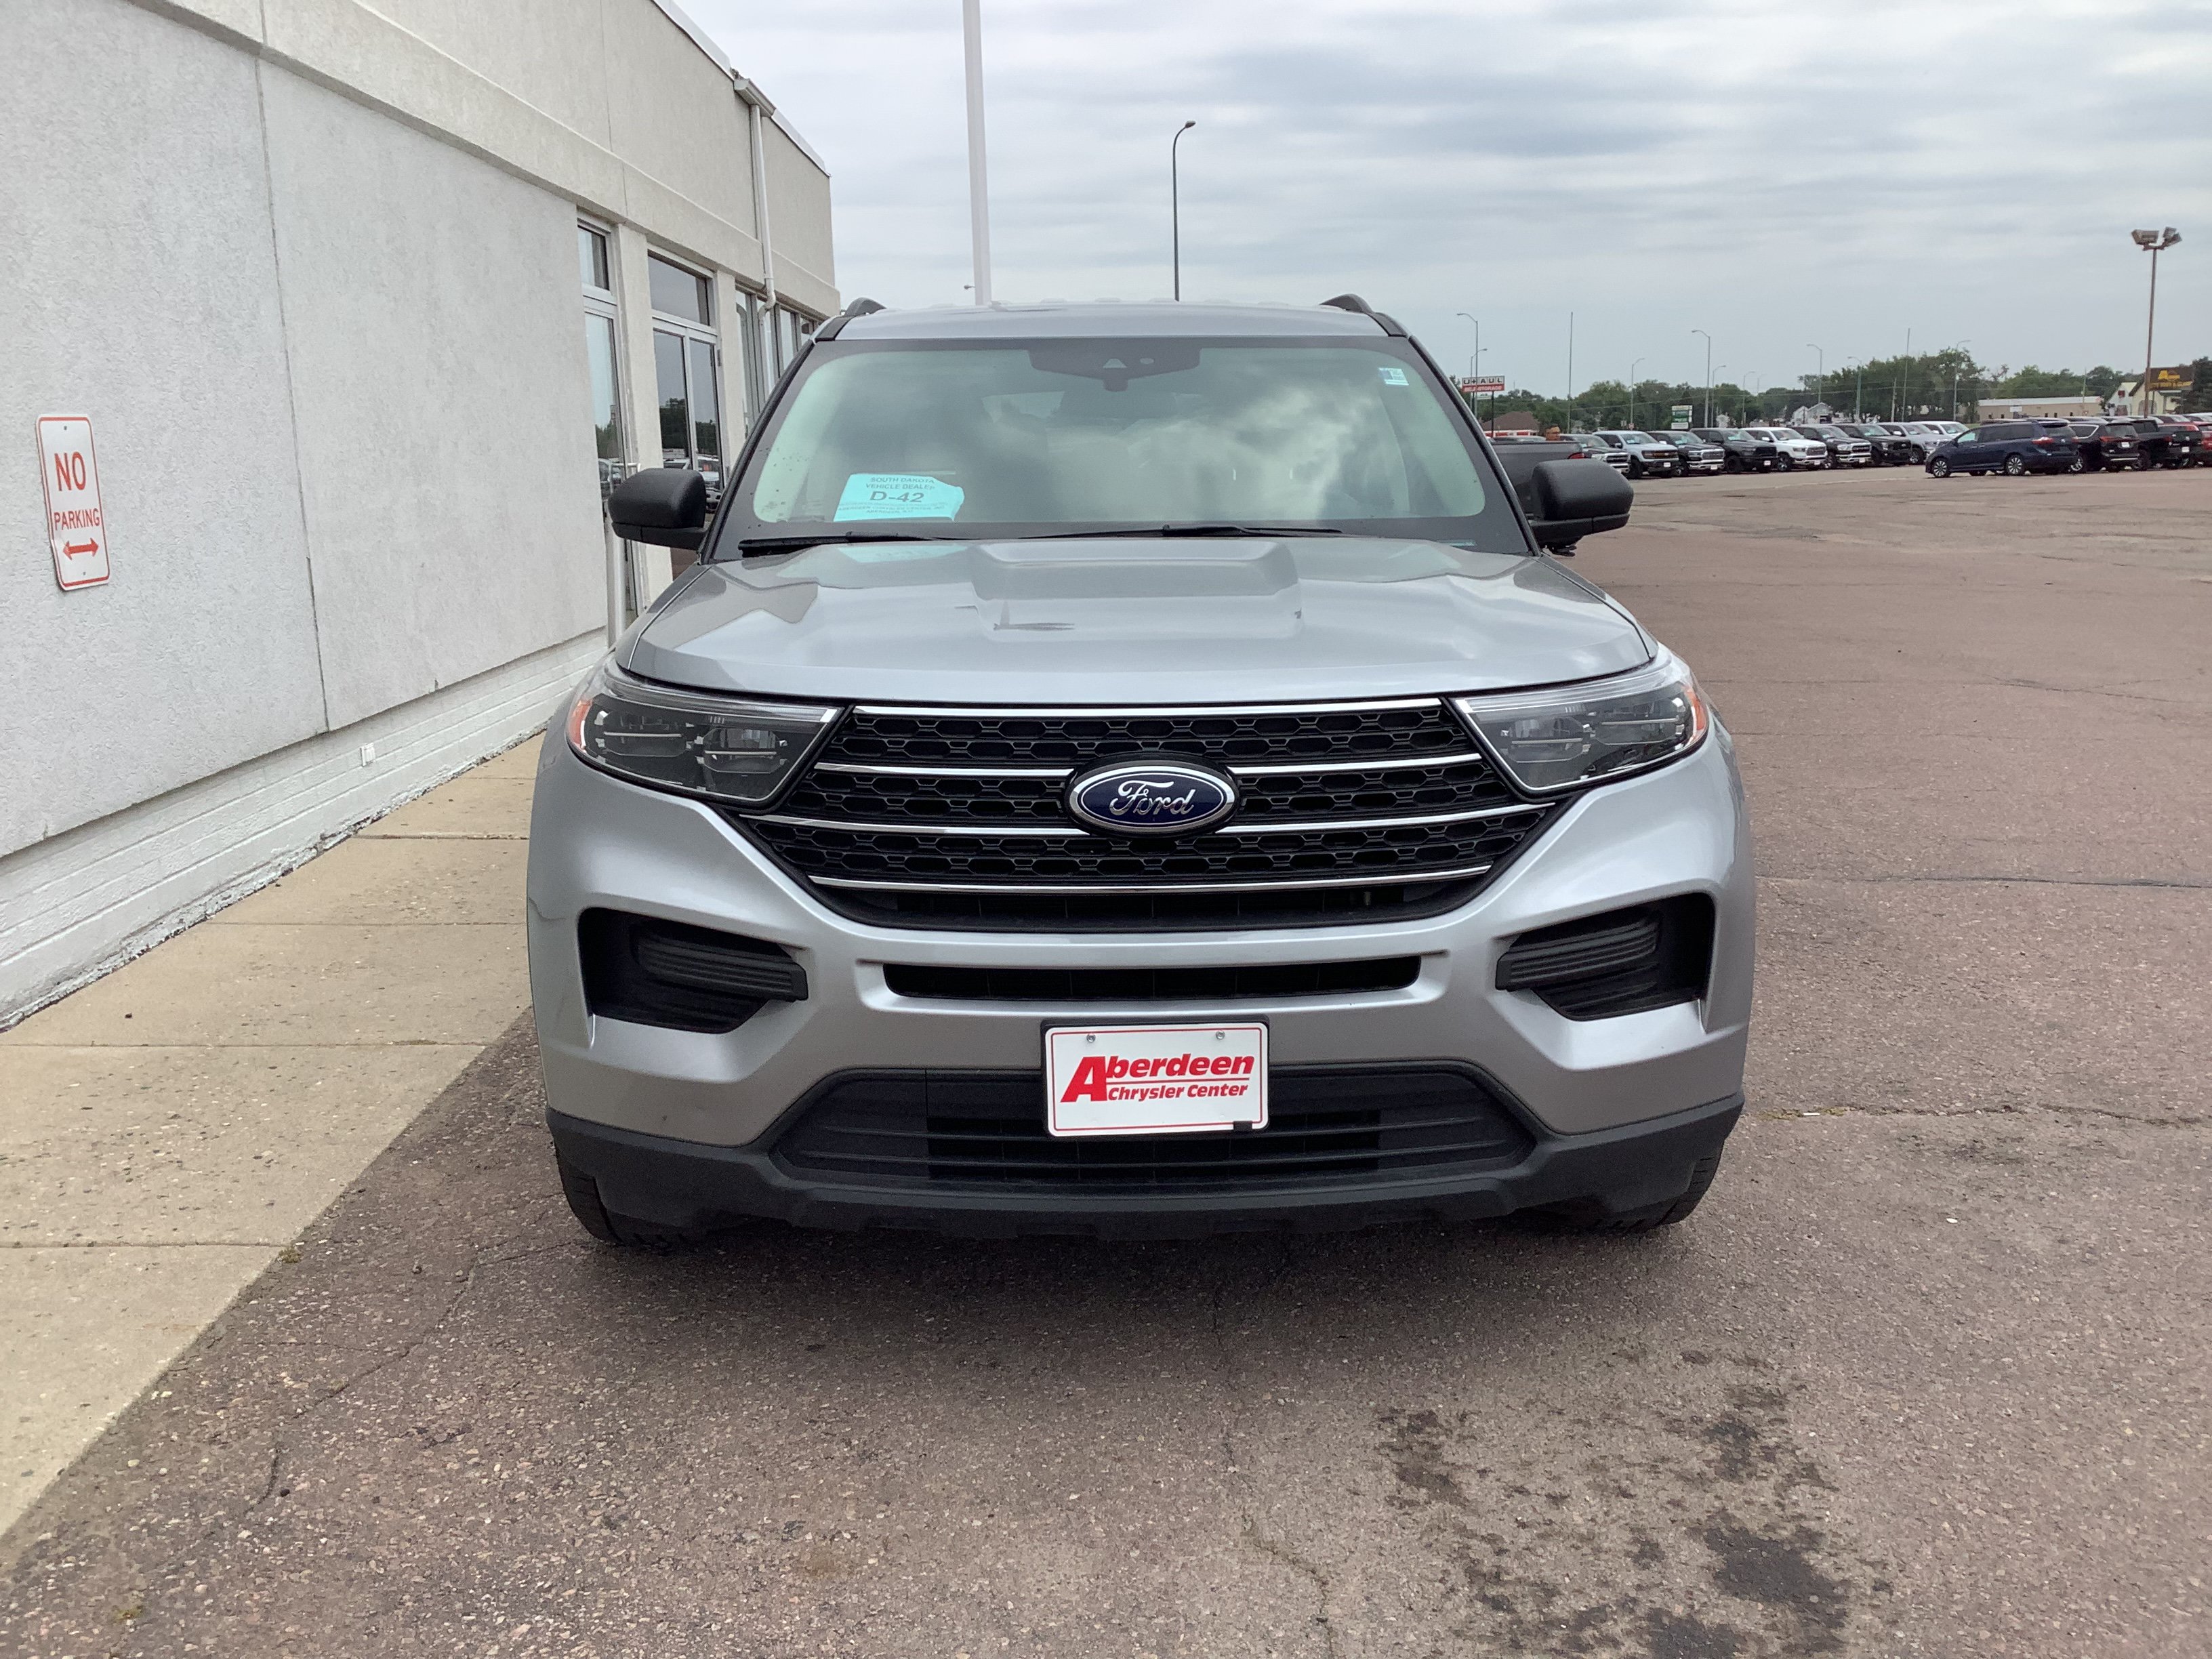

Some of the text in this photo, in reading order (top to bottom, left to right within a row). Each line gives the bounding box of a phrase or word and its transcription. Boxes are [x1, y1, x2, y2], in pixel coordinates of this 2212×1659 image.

[54, 451, 86, 491] NO
[869, 491, 924, 503] D-42
[54, 508, 100, 531] PARKING
[1109, 780, 1196, 816] Ford
[1060, 1053, 1254, 1103] Aberdeen
[1108, 1084, 1248, 1101] Chrysler Center
